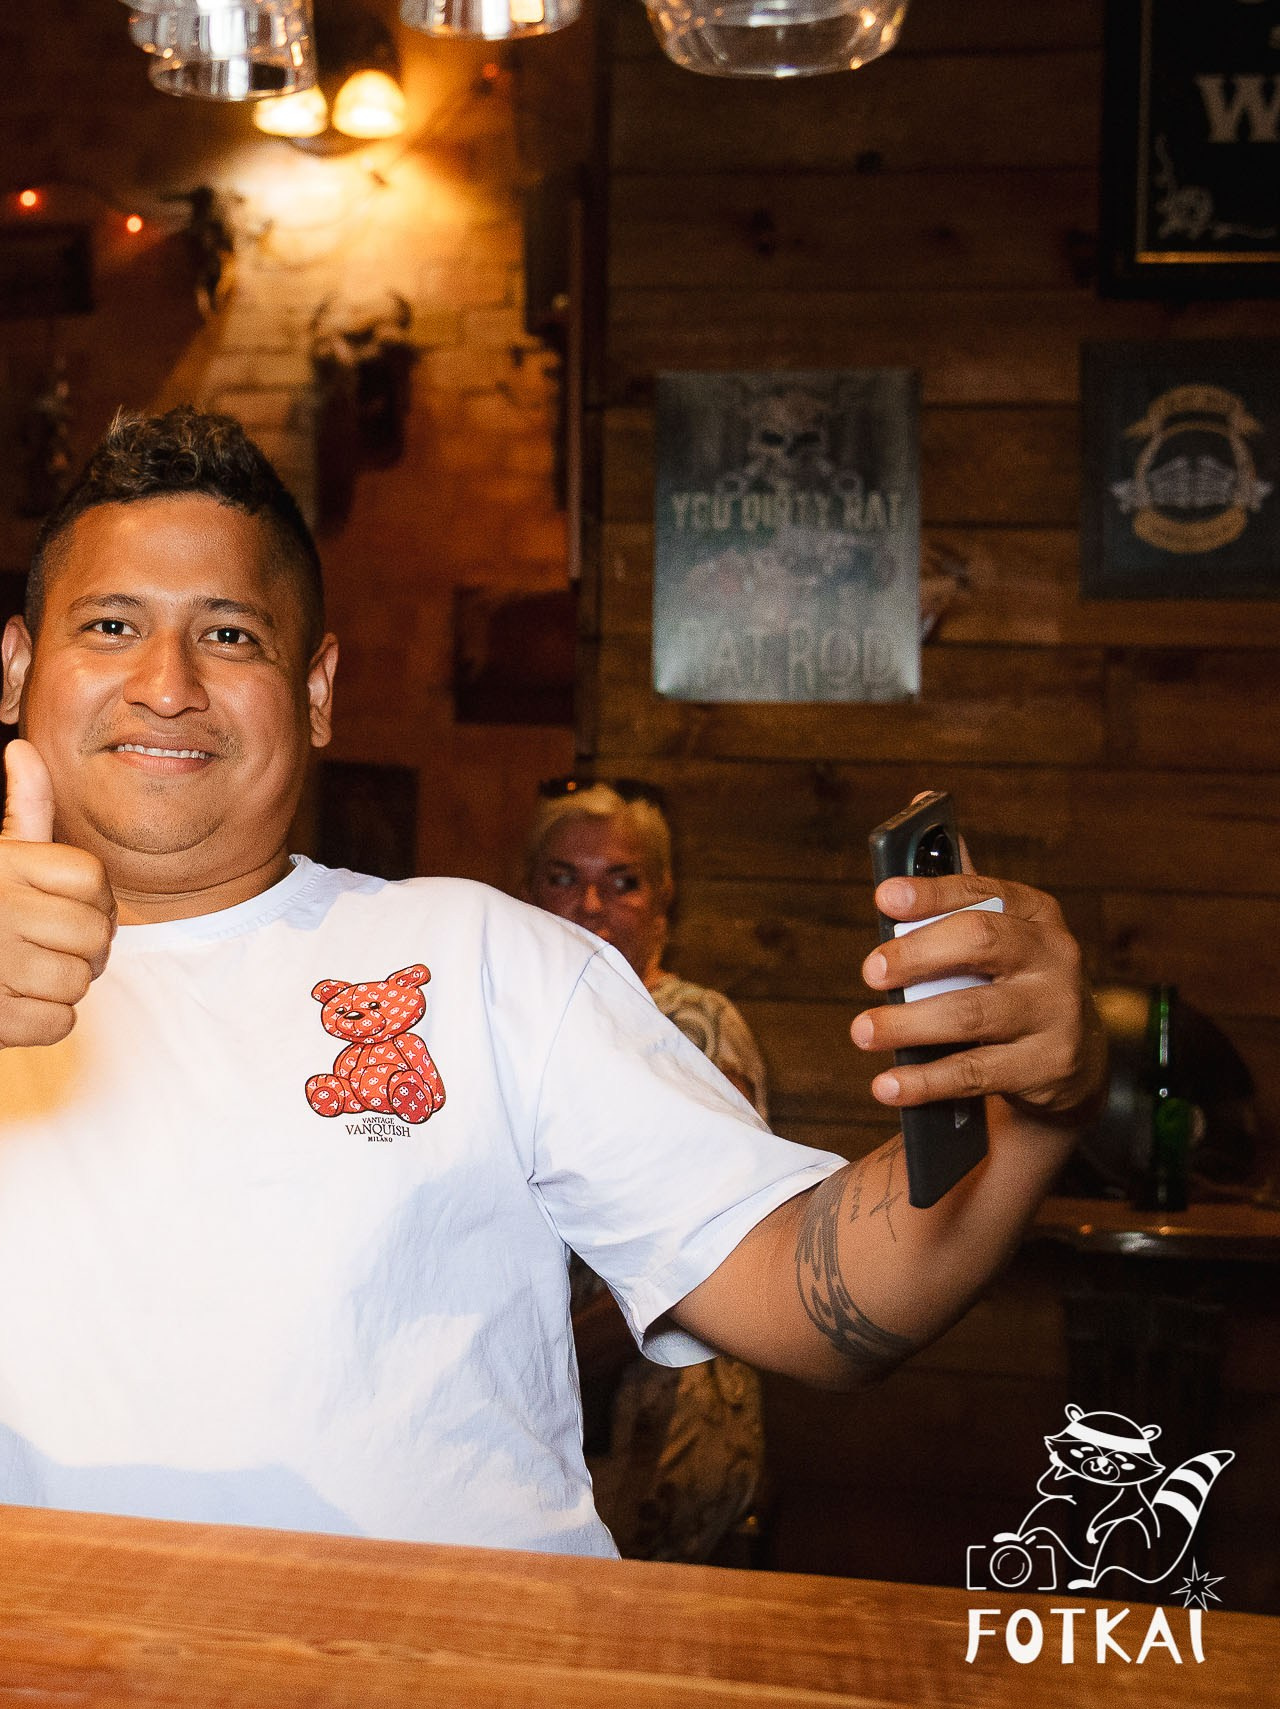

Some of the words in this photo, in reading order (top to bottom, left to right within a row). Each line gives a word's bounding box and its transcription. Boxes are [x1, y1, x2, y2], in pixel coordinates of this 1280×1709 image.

[672, 493, 733, 529] YOU
[362, 1117, 395, 1125] VANTAGE
[345, 1123, 411, 1138] VANQUISH
